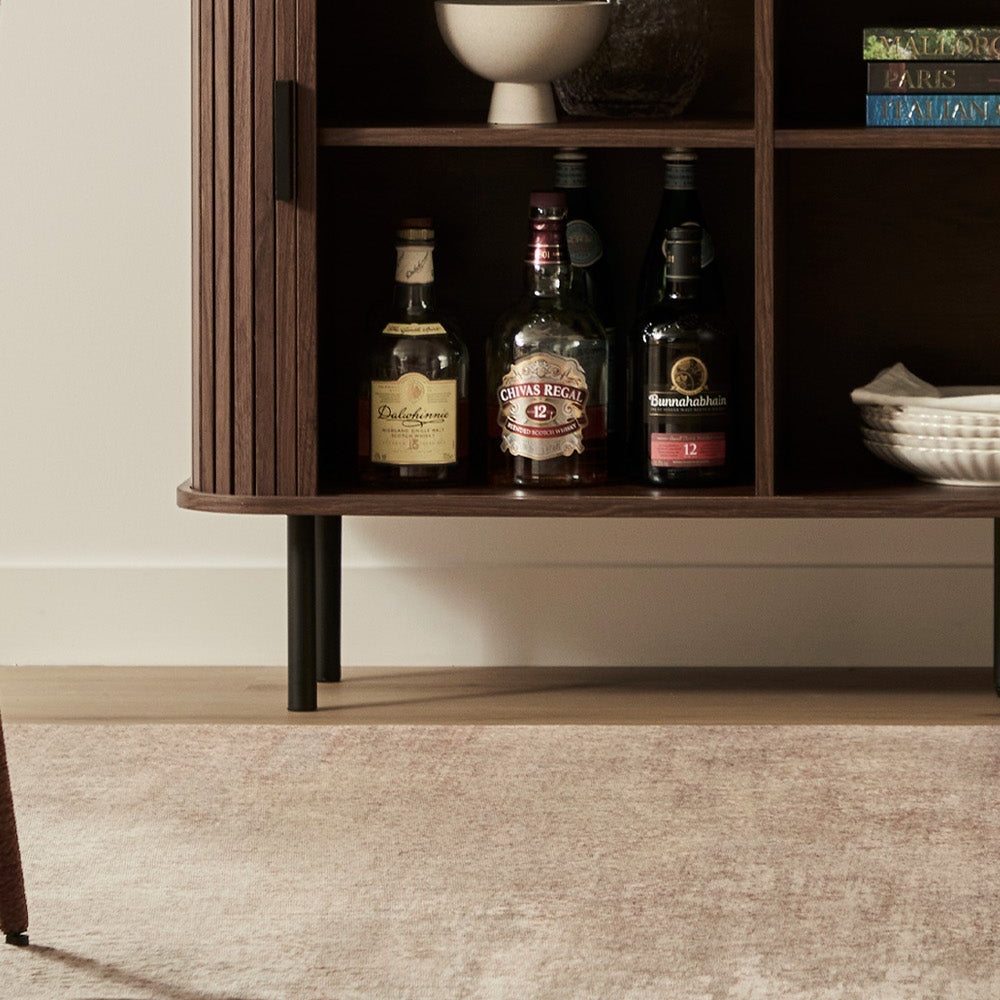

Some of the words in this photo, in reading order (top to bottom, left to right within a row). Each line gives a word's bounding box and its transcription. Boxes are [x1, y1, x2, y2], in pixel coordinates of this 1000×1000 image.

[883, 69, 956, 89] PARIS
[881, 100, 989, 121] ITALIAN
[500, 384, 540, 402] CHIVAS
[543, 384, 583, 402] REGAL
[648, 394, 727, 408] Bunnahabhain
[377, 404, 449, 420] Dalwhinnie
[533, 405, 547, 418] 12
[683, 443, 697, 455] 12
